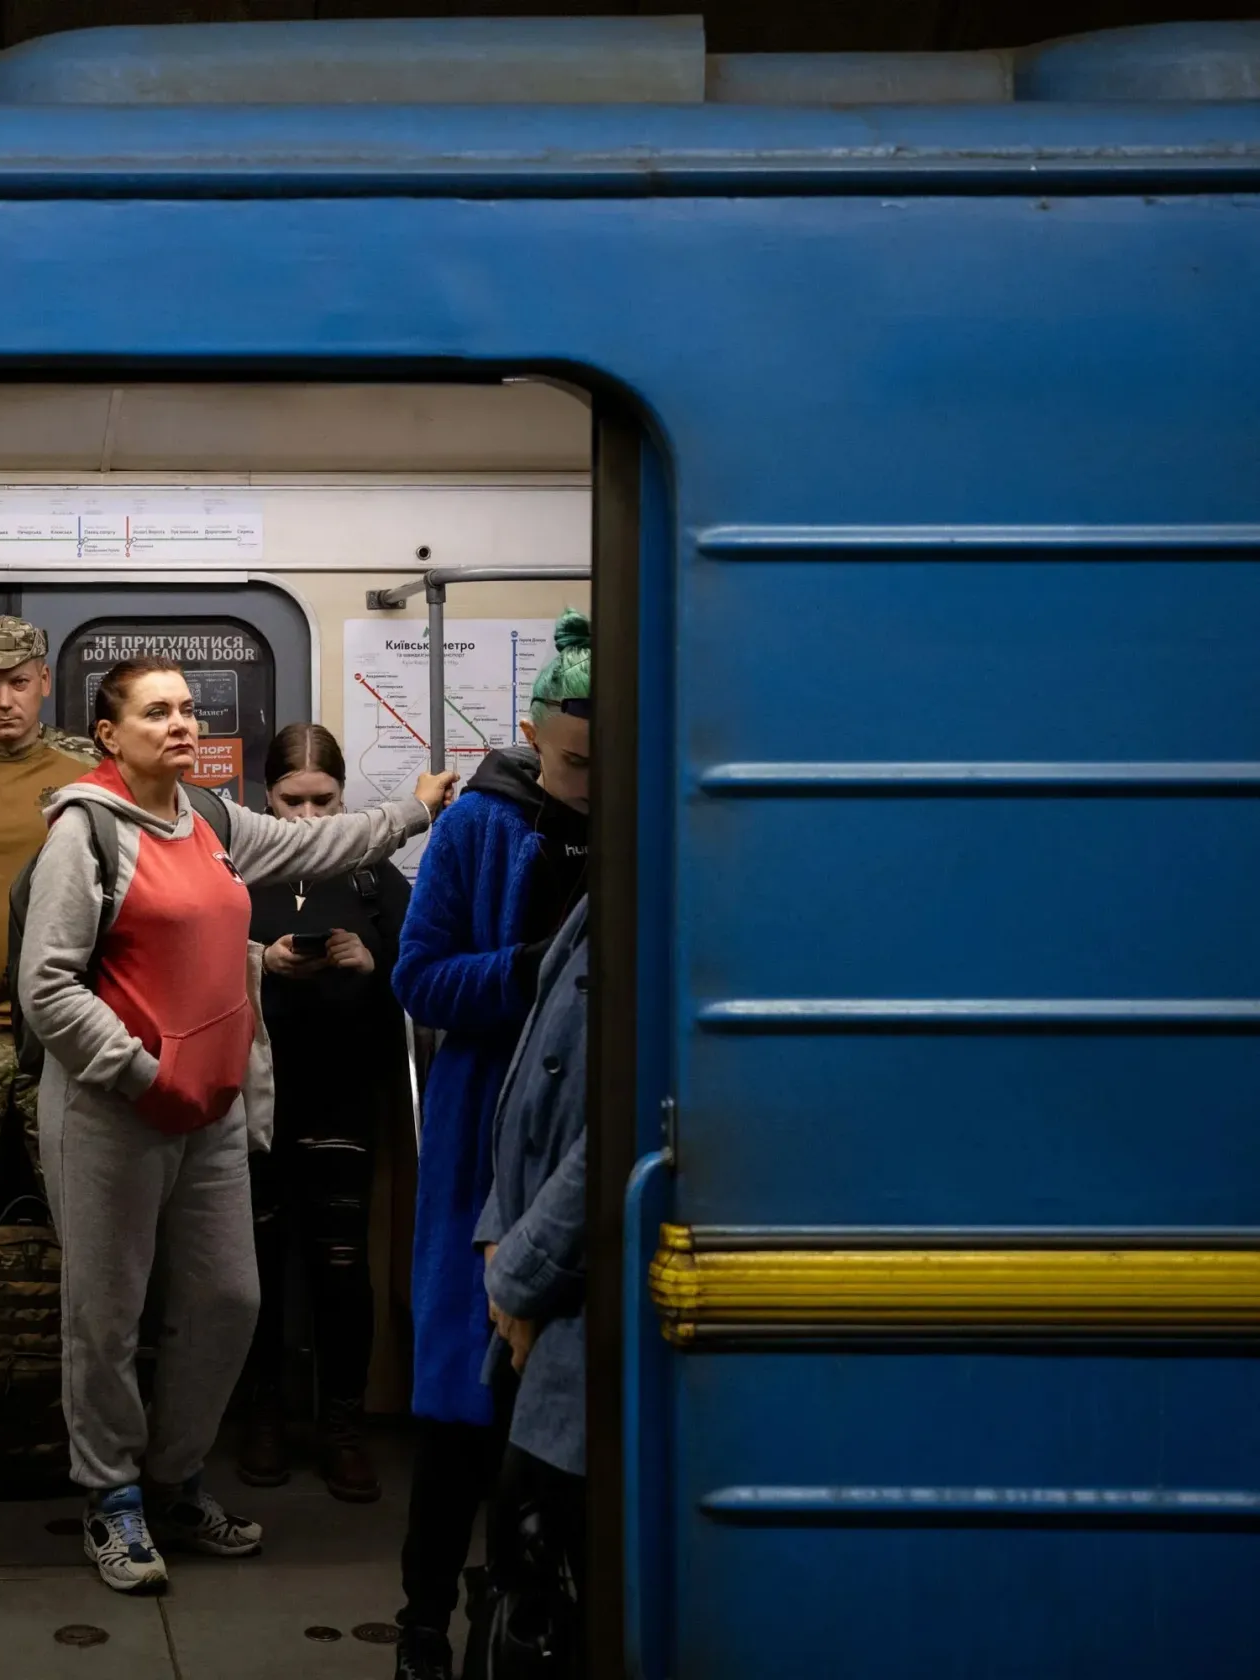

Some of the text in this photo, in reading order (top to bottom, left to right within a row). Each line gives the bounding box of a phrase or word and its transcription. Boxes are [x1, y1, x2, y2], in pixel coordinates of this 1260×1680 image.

[95, 636, 243, 649] НЕ ПРИТУЛЯТИСЯ
[385, 640, 430, 651] Київськ
[83, 649, 105, 661] DO
[109, 648, 140, 661] NOT
[186, 648, 208, 661] ON
[212, 648, 255, 661] DOOR
[203, 763, 233, 774] ГРН
